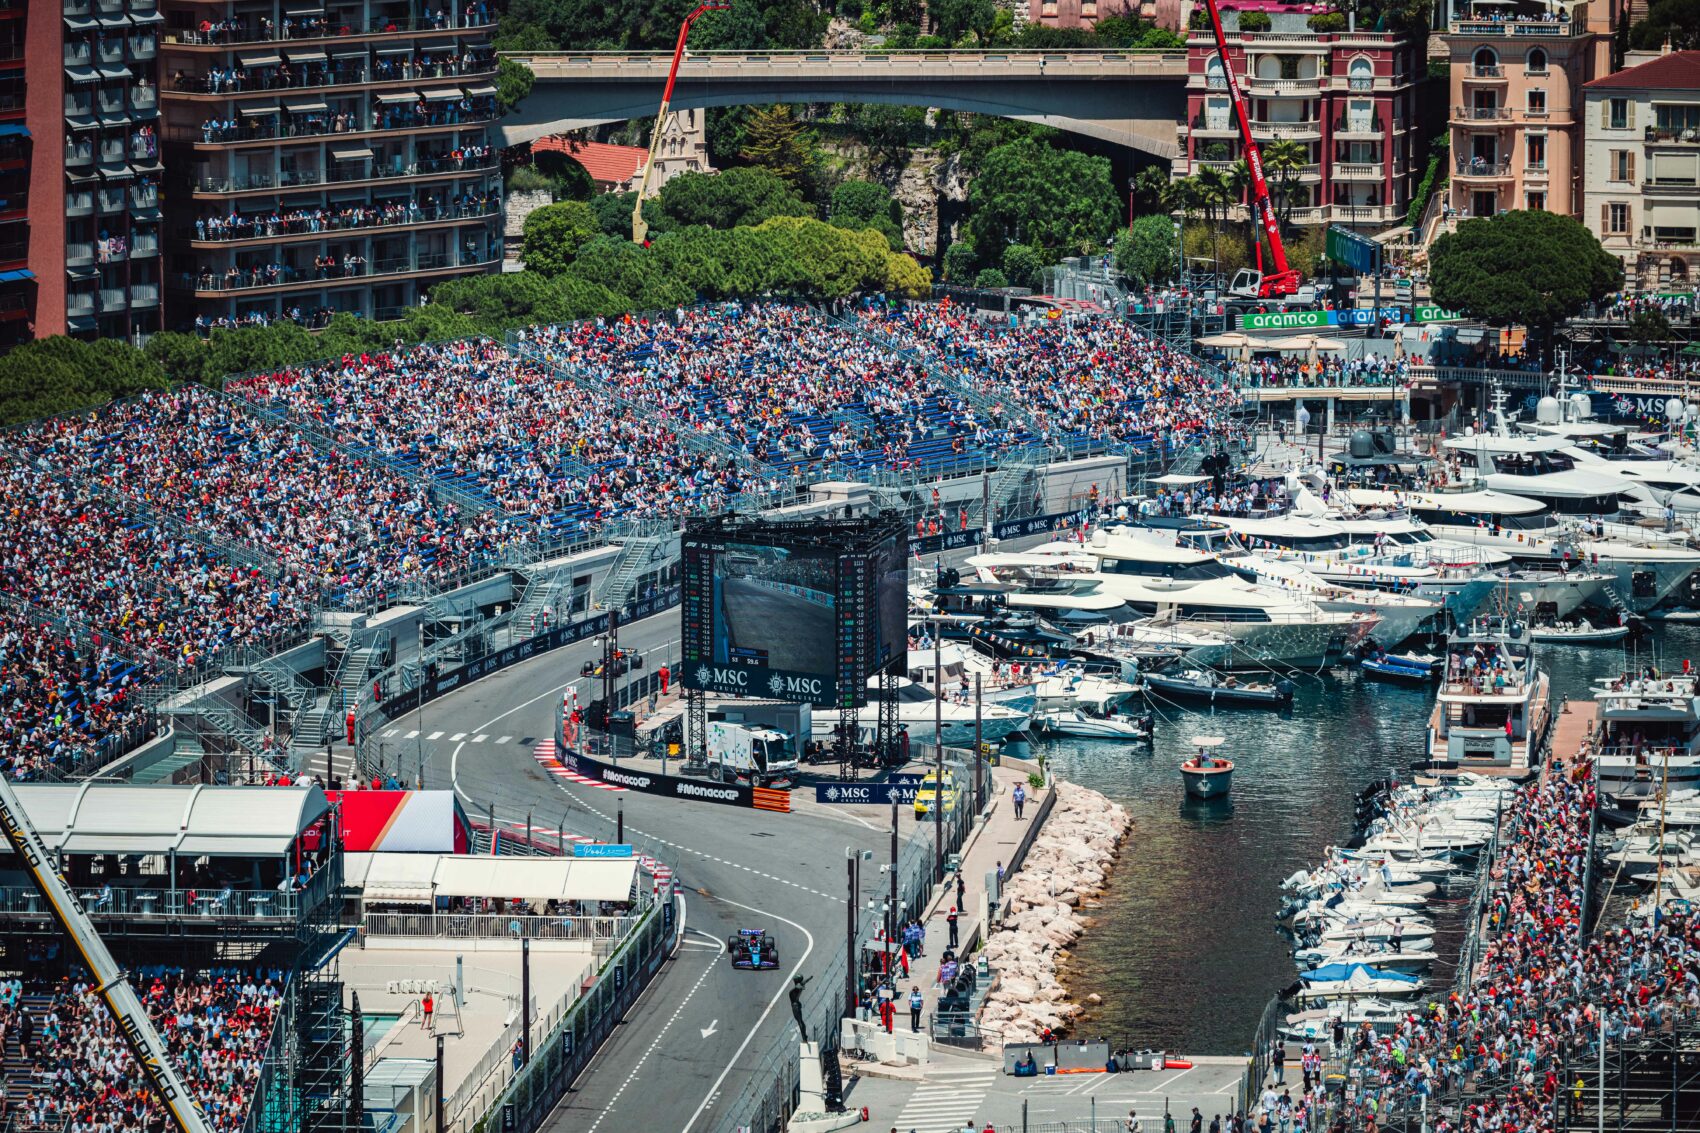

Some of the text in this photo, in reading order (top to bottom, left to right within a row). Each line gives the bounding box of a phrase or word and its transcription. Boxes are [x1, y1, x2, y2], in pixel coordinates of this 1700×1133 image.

[1253, 313, 1318, 326] aramco
[1636, 397, 1664, 413] MS
[1006, 524, 1021, 535] MSC
[953, 534, 967, 544] MSC
[713, 668, 748, 686] MSC
[714, 685, 748, 694] CRUISES
[786, 677, 822, 695] MSC
[787, 693, 822, 702] CRUISES
[602, 769, 651, 788] #MonacoGP
[676, 783, 739, 800] #MonacoGP
[841, 788, 870, 798] MSC
[583, 845, 606, 857] Pool
[121, 1013, 178, 1101] MEDIACO
